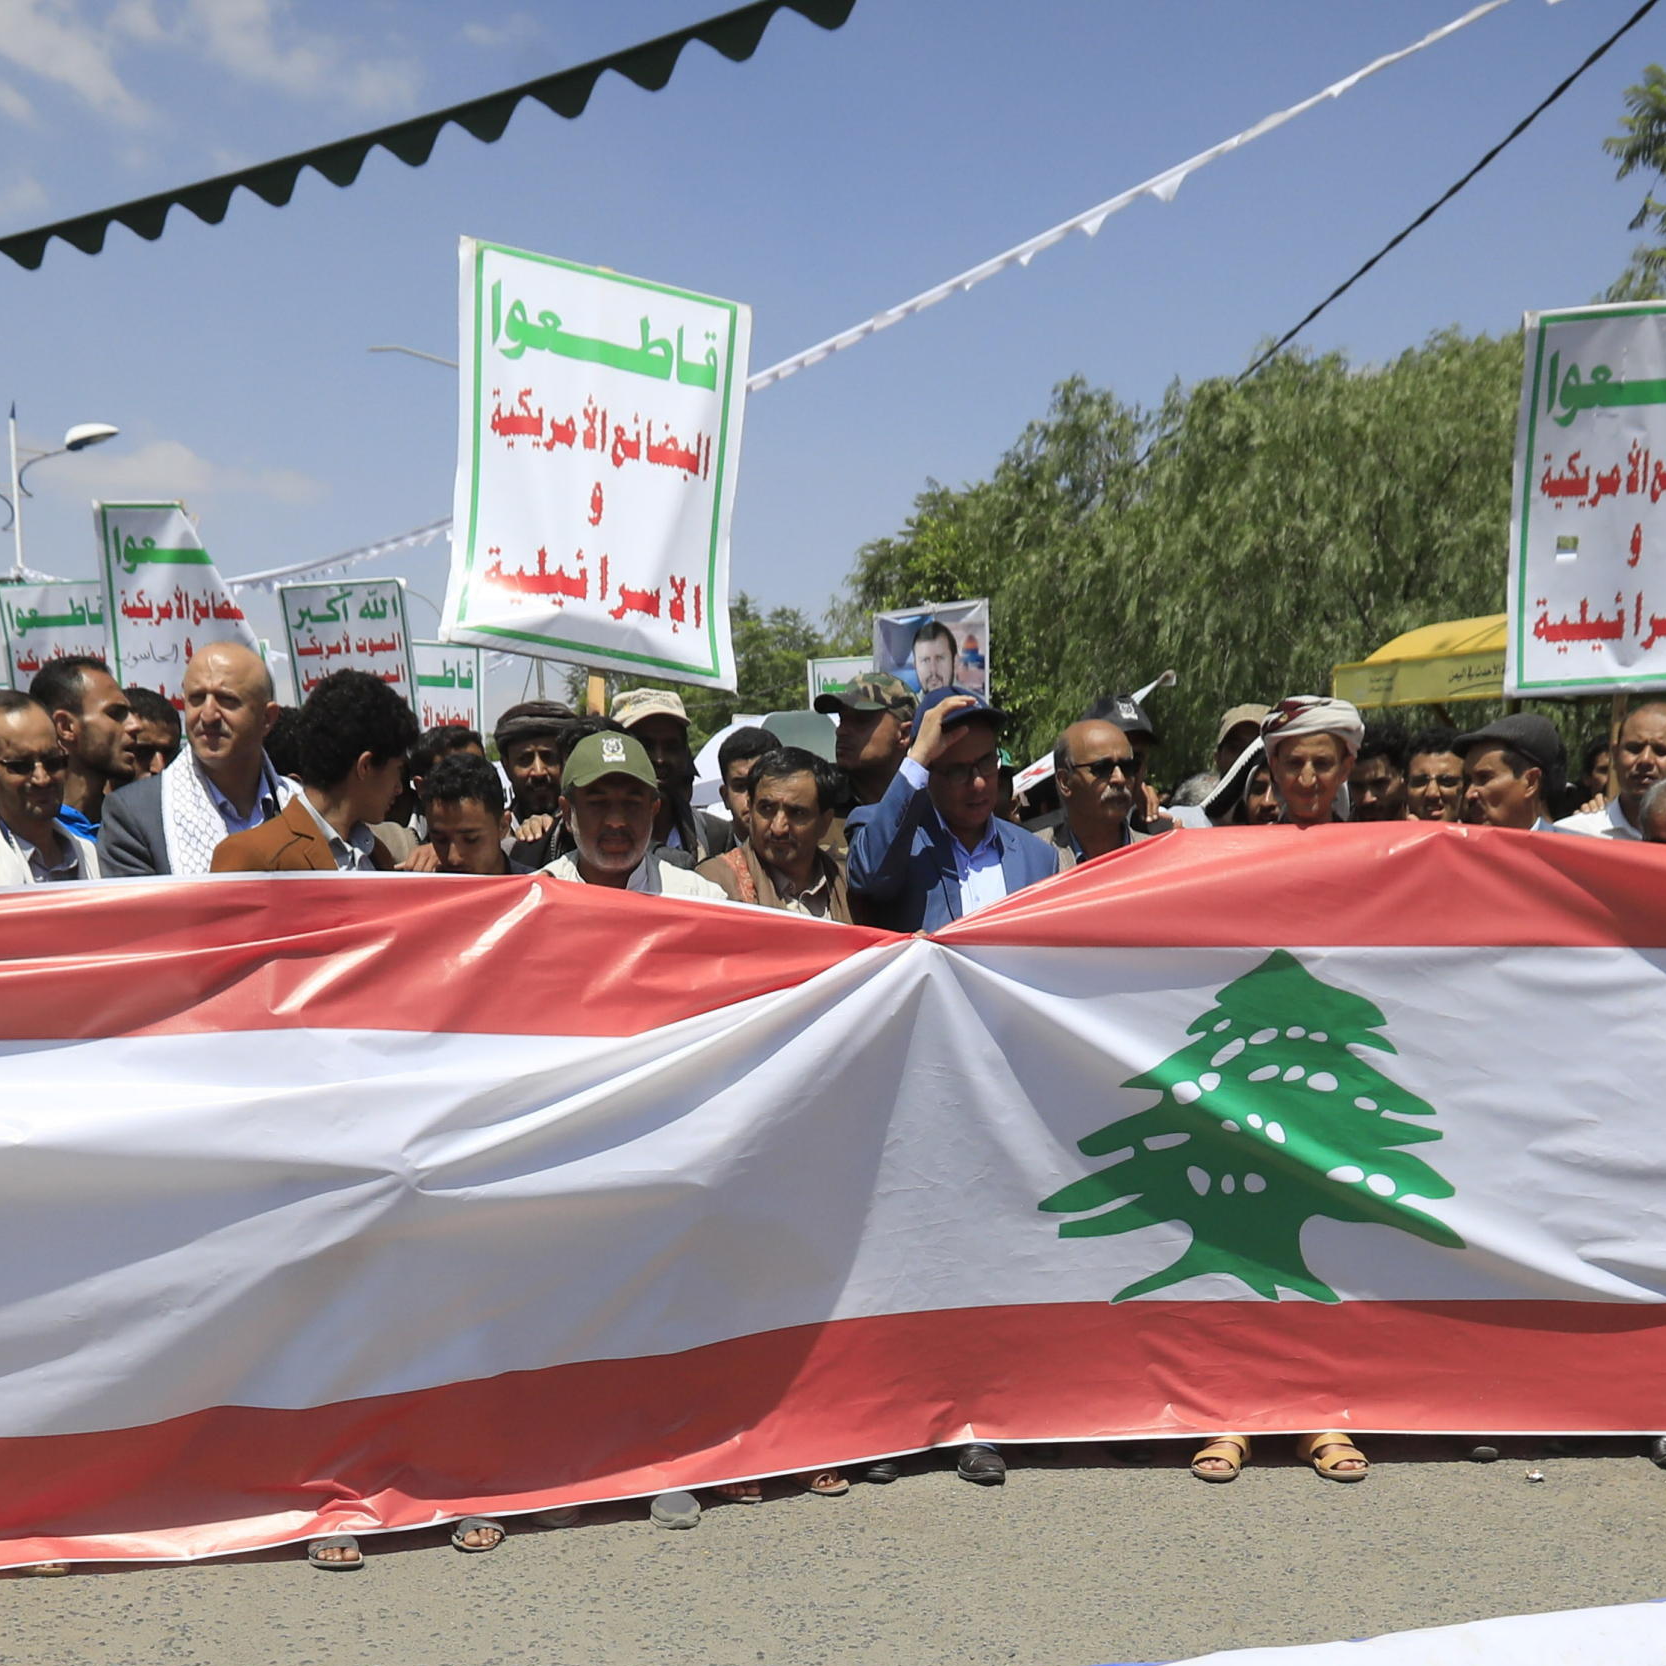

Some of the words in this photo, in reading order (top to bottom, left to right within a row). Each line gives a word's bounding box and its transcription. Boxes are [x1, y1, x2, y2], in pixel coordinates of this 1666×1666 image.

[491, 279, 718, 392] قاطعوا
[490, 388, 608, 452] الأمريكية
[612, 412, 711, 481] البضائع
[1540, 438, 1650, 508] الأمريكية
[588, 481, 604, 527] و
[1627, 522, 1643, 568] و
[120, 584, 190, 626] الأمريكية
[292, 586, 353, 635] أكبر
[484, 545, 703, 635] الإسرائيلية
[294, 631, 351, 660] لأمريكا
[355, 631, 402, 657] الموت
